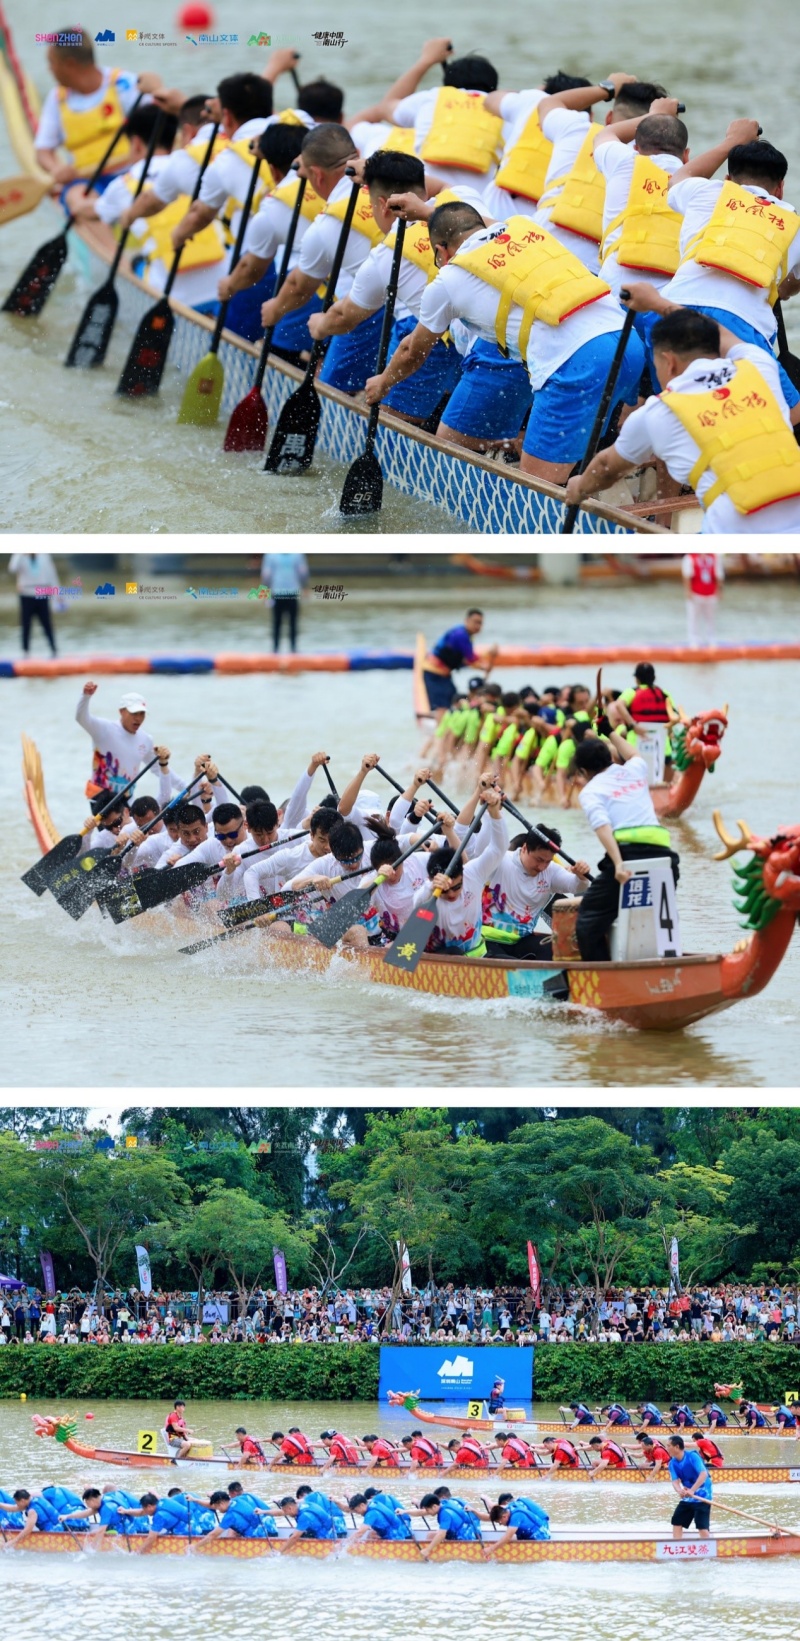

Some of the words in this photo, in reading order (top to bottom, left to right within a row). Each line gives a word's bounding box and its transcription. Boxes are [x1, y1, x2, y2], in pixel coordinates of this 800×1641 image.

[788, 1393, 796, 1403] 4
[470, 1404, 480, 1417] 3
[141, 1433, 153, 1451] 2
